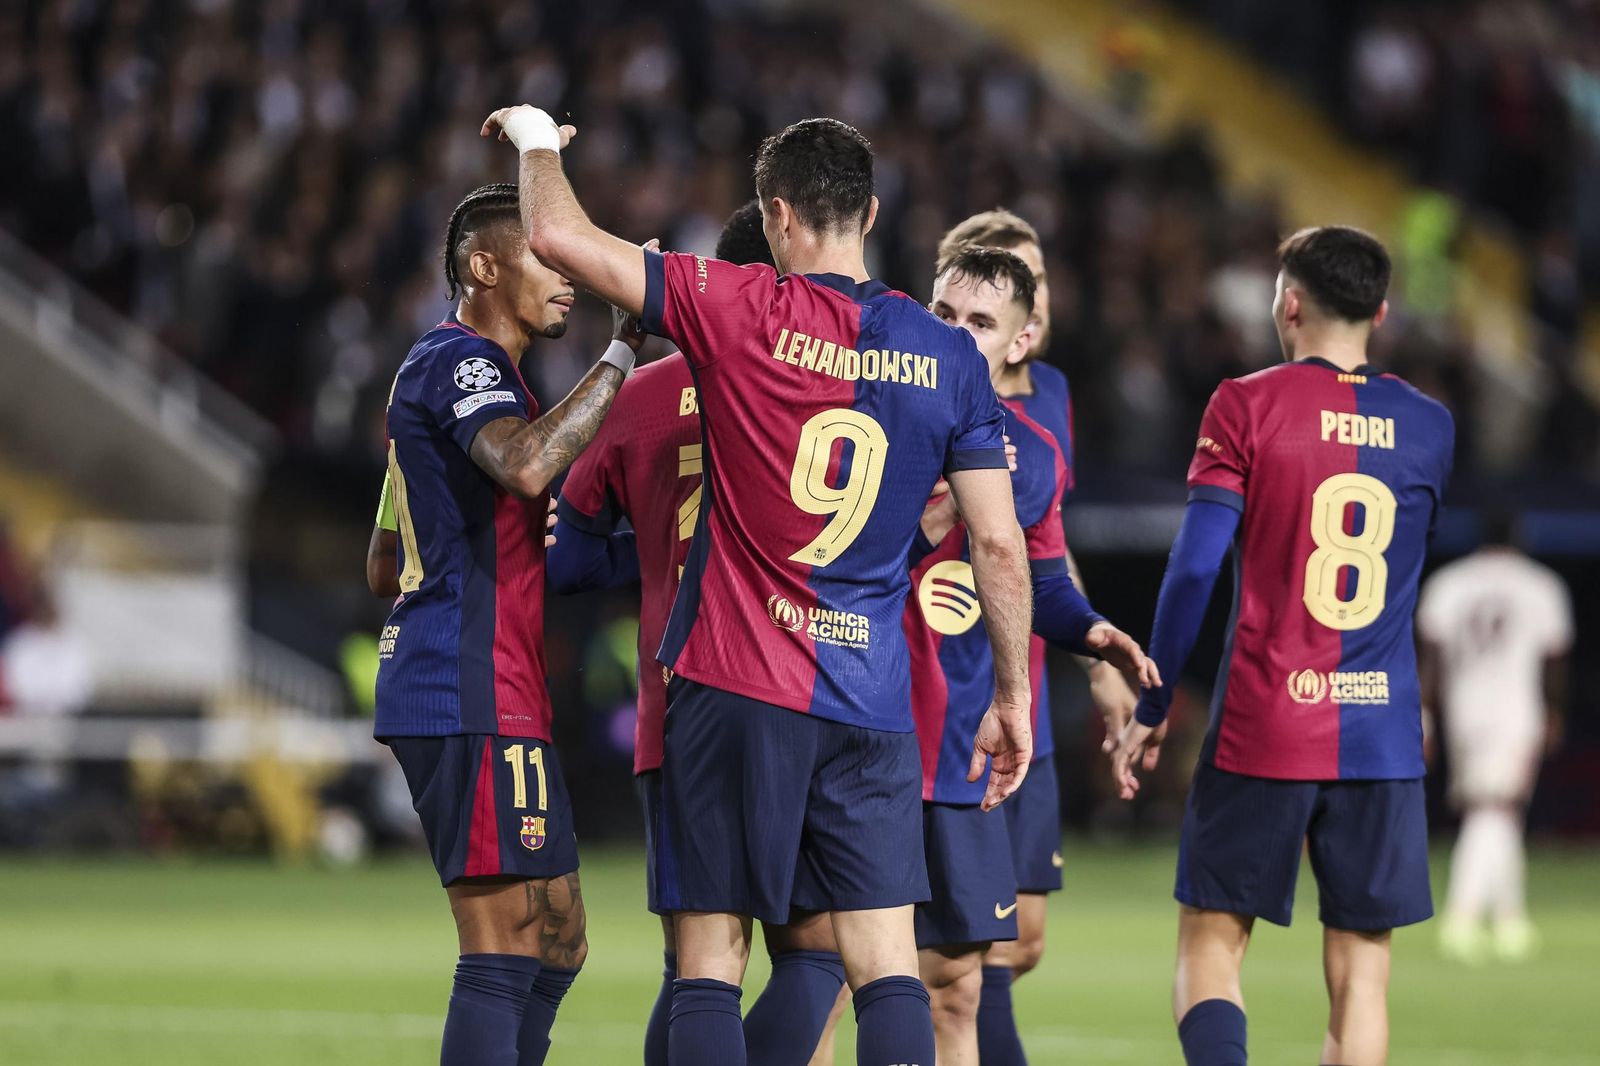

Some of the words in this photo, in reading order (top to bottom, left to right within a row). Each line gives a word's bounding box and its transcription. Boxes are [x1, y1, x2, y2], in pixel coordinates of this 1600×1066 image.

[772, 328, 938, 390] LEWANDOWSKI
[456, 394, 513, 414] FOUNDATION
[1320, 410, 1395, 450] PEDRI
[787, 408, 889, 568] 9
[1303, 472, 1398, 631] 8
[806, 621, 870, 643] ACNUR
[807, 607, 870, 629] UNHCR
[1328, 671, 1388, 685] UNHCR
[1329, 684, 1389, 699] ACNUR
[503, 744, 548, 811] 11
